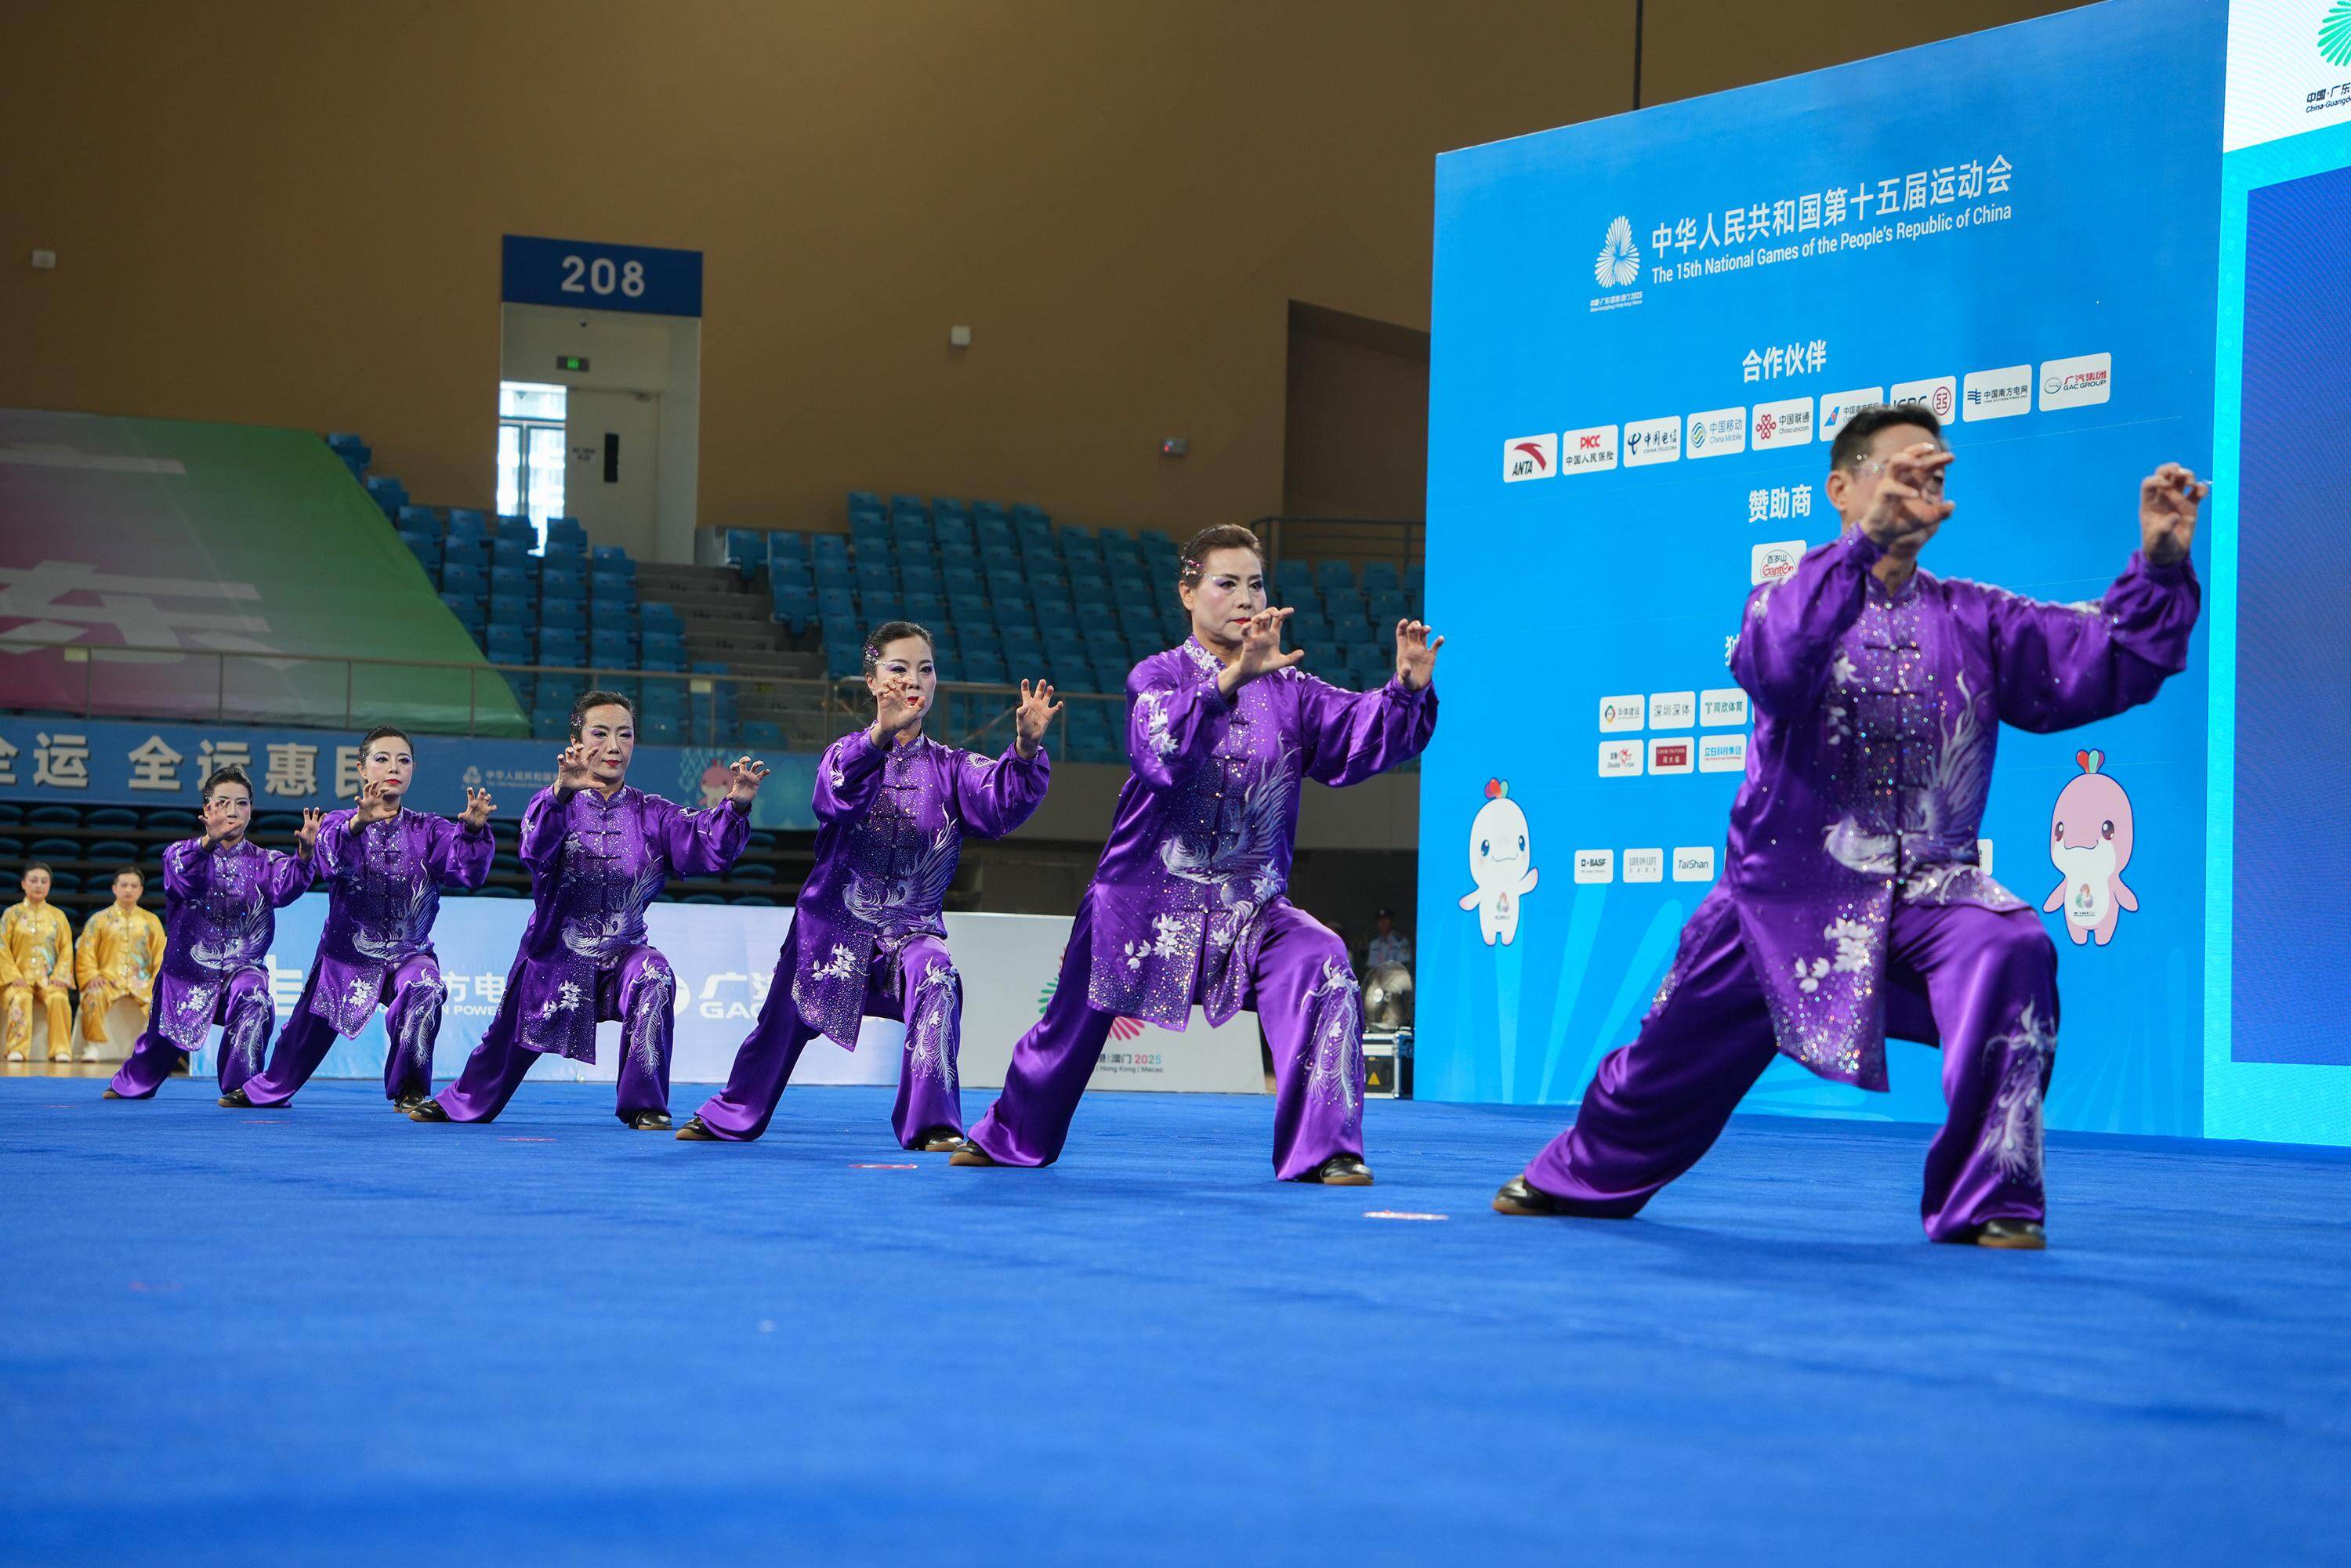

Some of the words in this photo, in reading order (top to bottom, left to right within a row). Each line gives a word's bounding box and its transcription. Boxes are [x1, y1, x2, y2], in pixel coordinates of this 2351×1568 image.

[1651, 154, 2012, 259] 中华人民共和国第十五届运动会
[1651, 267, 1673, 284] The
[1676, 259, 1702, 280] 15th
[1704, 249, 1755, 276] National
[1757, 246, 1799, 266] Games
[1802, 237, 1816, 257] of
[1817, 235, 1838, 255] the
[1840, 225, 1893, 250] People's
[1896, 214, 1953, 241] Republic
[1955, 208, 1971, 229] of
[1972, 202, 2012, 226] China
[560, 255, 645, 298] 208
[1741, 339, 1827, 383] 合作伙伴
[2063, 370, 2106, 385] 广汽集团
[2079, 379, 2106, 389] GROUP
[1983, 385, 2028, 400] 中国南方电网
[1778, 411, 1809, 425] 中国联通
[1709, 418, 1743, 434] 中国移动
[1580, 434, 1601, 451] PICC
[1643, 428, 1677, 448] 中国电信
[1709, 436, 1724, 444] China
[1726, 433, 1742, 442] Mobile
[1566, 451, 1614, 466] 中国人民保险
[1512, 460, 1534, 476] ANTA
[1748, 483, 1813, 523] 赞助商
[1767, 554, 1788, 564] 百岁山
[1654, 702, 1690, 718] 深圳深体
[1704, 745, 1742, 757] 立白科技集团
[486, 770, 558, 781] 中华人民共和国
[1589, 858, 1607, 867] BASF
[1677, 859, 1709, 870] TaiShan
[1134, 1053, 1161, 1064] 2025
